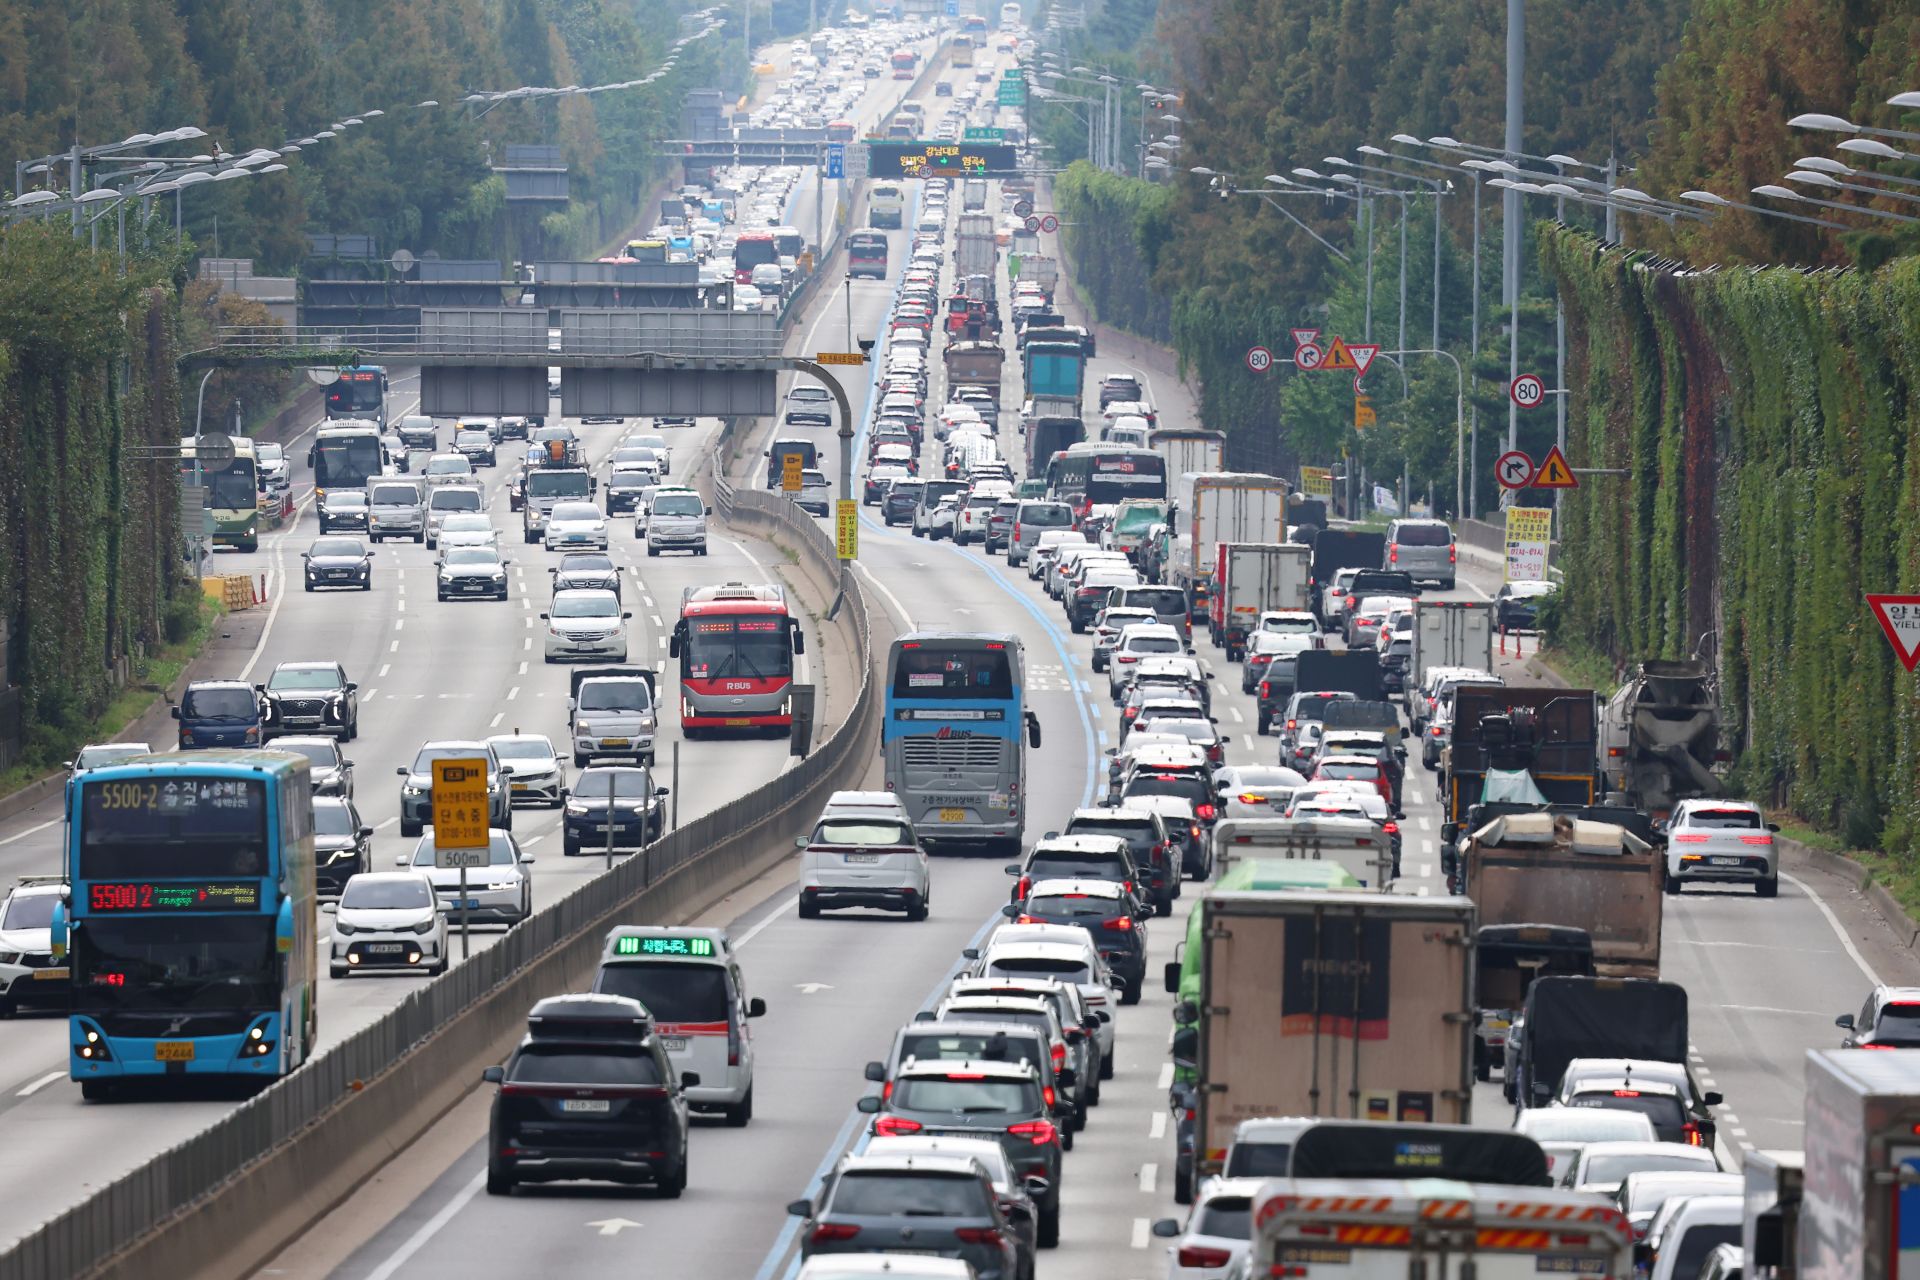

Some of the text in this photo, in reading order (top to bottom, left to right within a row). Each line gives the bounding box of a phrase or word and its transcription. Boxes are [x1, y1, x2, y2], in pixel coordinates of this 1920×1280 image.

[925, 146, 960, 156] 강남대로
[1251, 354, 1267, 366] 80
[1518, 383, 1538, 399] 80
[102, 783, 157, 809] 5500-2
[446, 852, 480, 865] 500m
